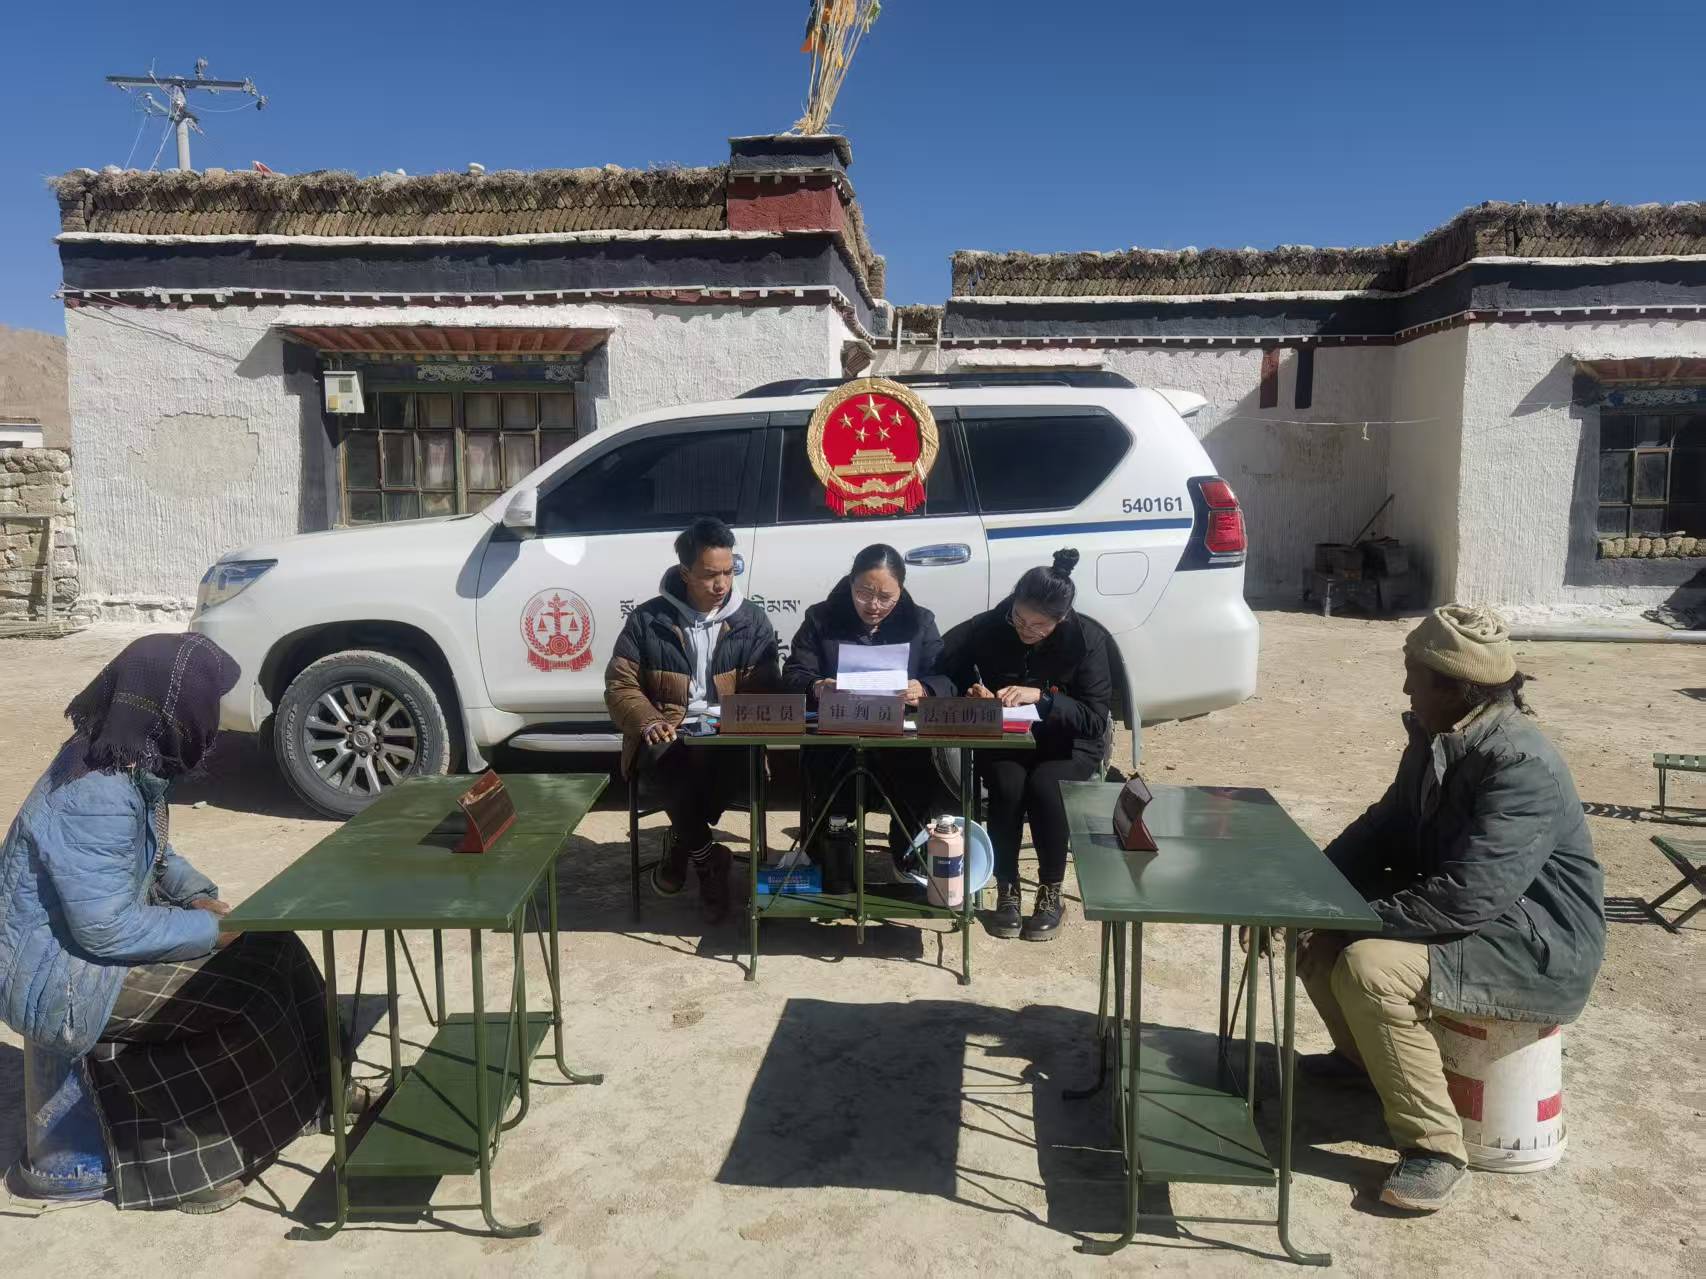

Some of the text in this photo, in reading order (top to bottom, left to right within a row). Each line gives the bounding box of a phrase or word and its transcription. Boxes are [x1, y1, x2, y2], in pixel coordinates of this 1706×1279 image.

[1122, 496, 1183, 513] 540161
[830, 703, 891, 721] 审判员
